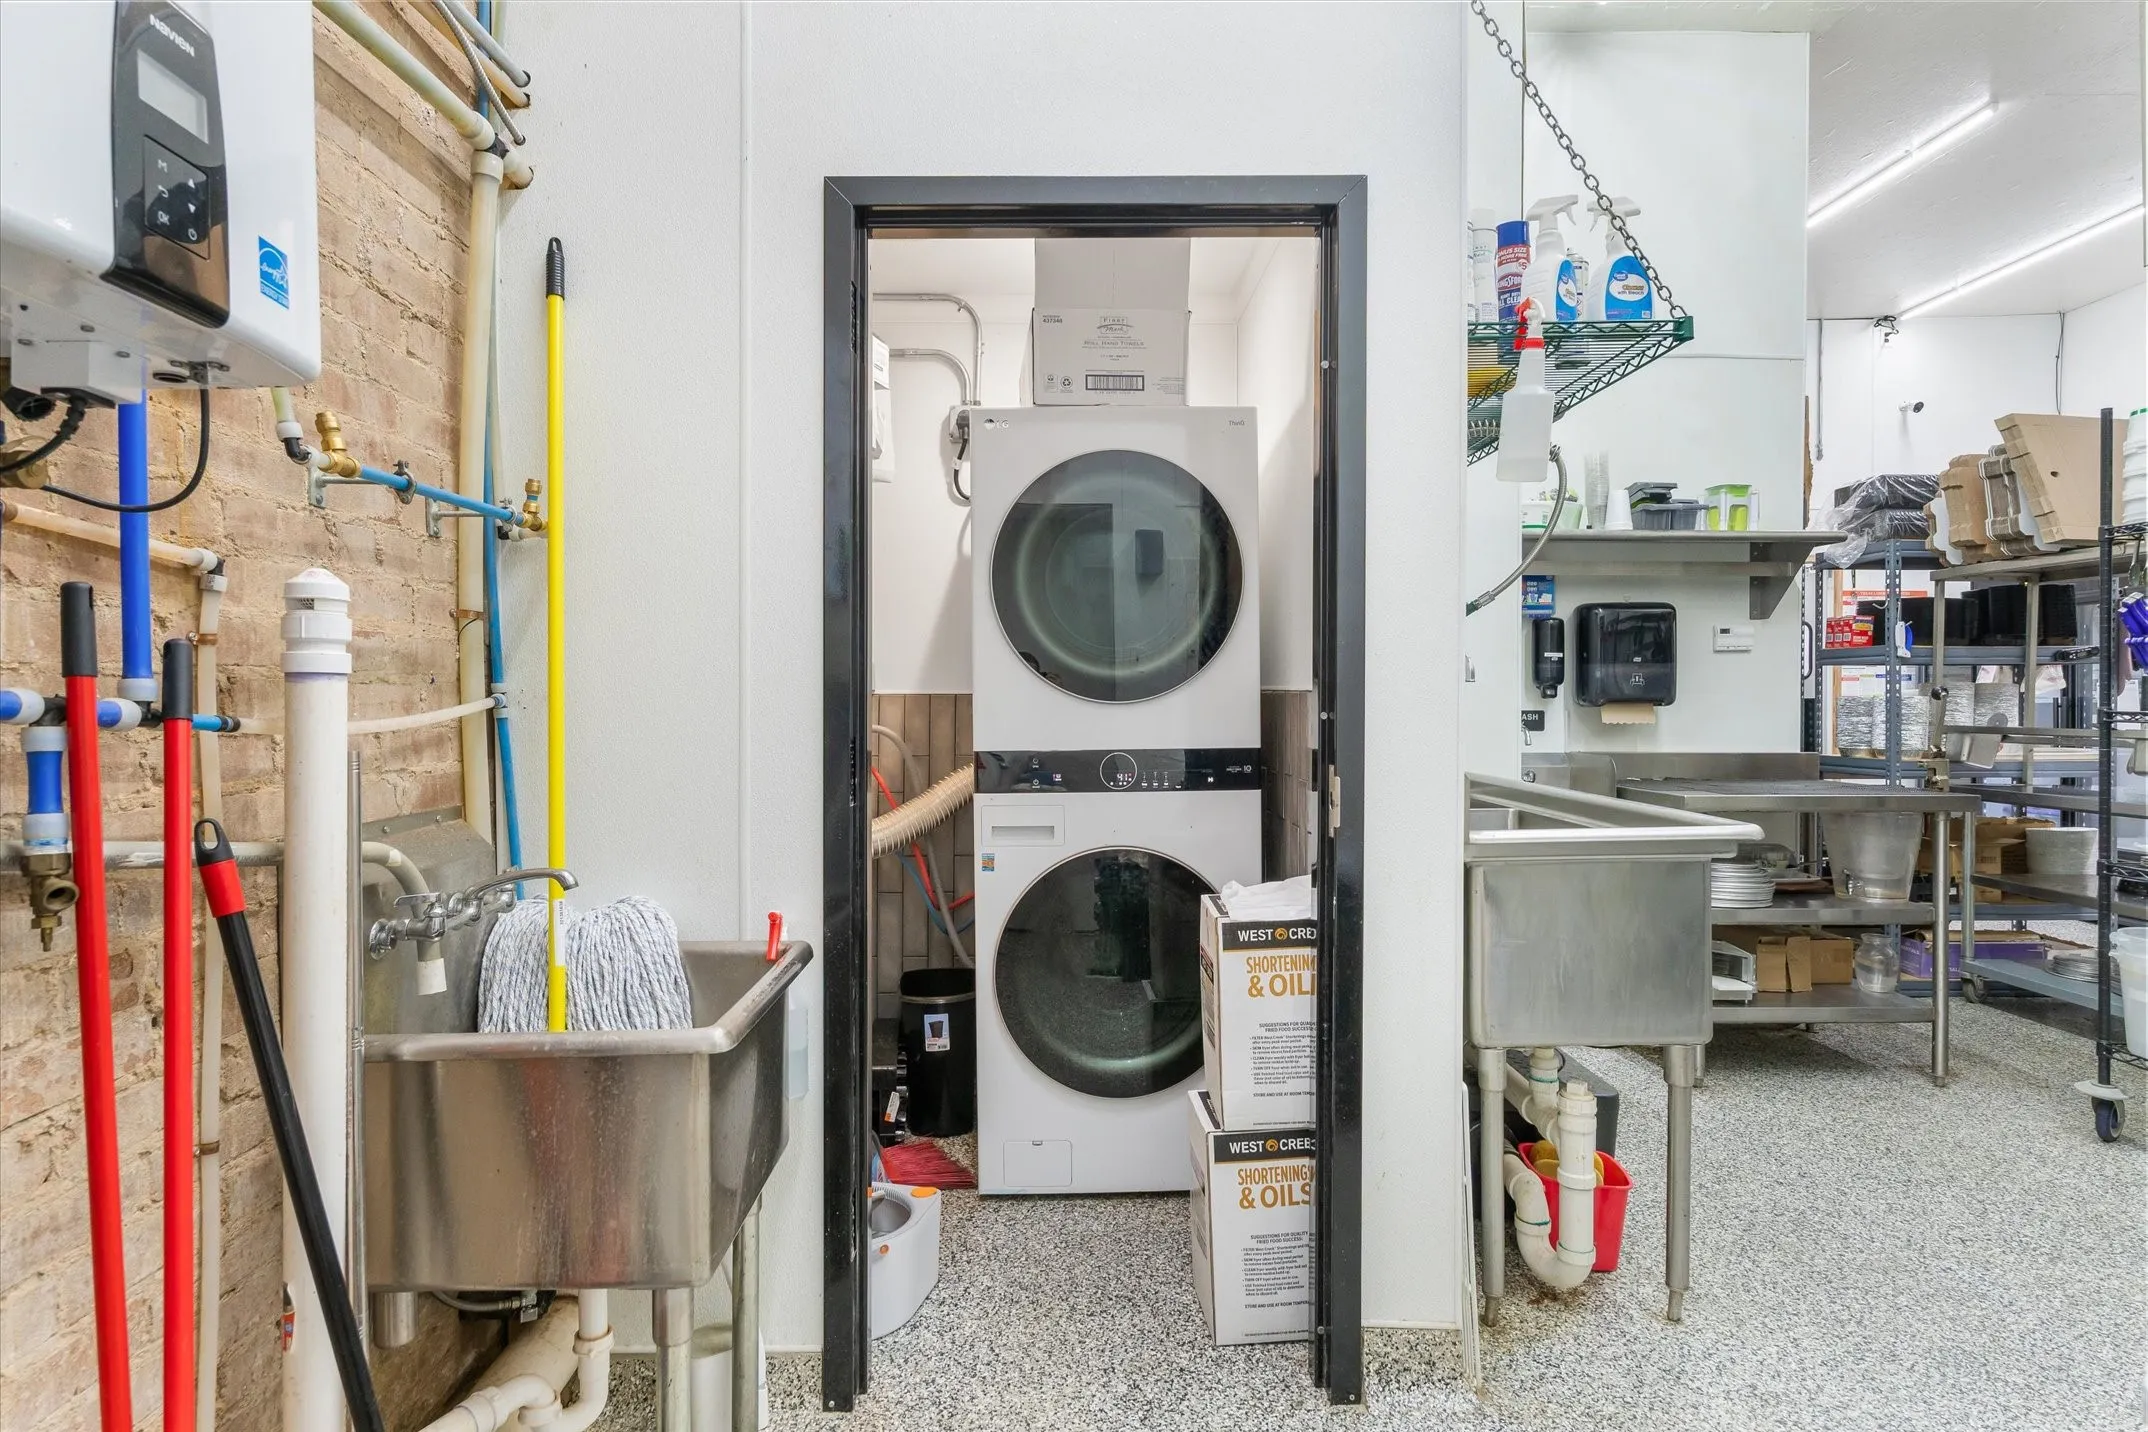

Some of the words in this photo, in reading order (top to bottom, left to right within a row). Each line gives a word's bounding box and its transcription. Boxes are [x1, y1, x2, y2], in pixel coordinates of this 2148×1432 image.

[1237, 929, 1274, 942] WEST
[1247, 975, 1265, 998] &
[1229, 1141, 1264, 1154] WEST
[1239, 1186, 1256, 1209] &
